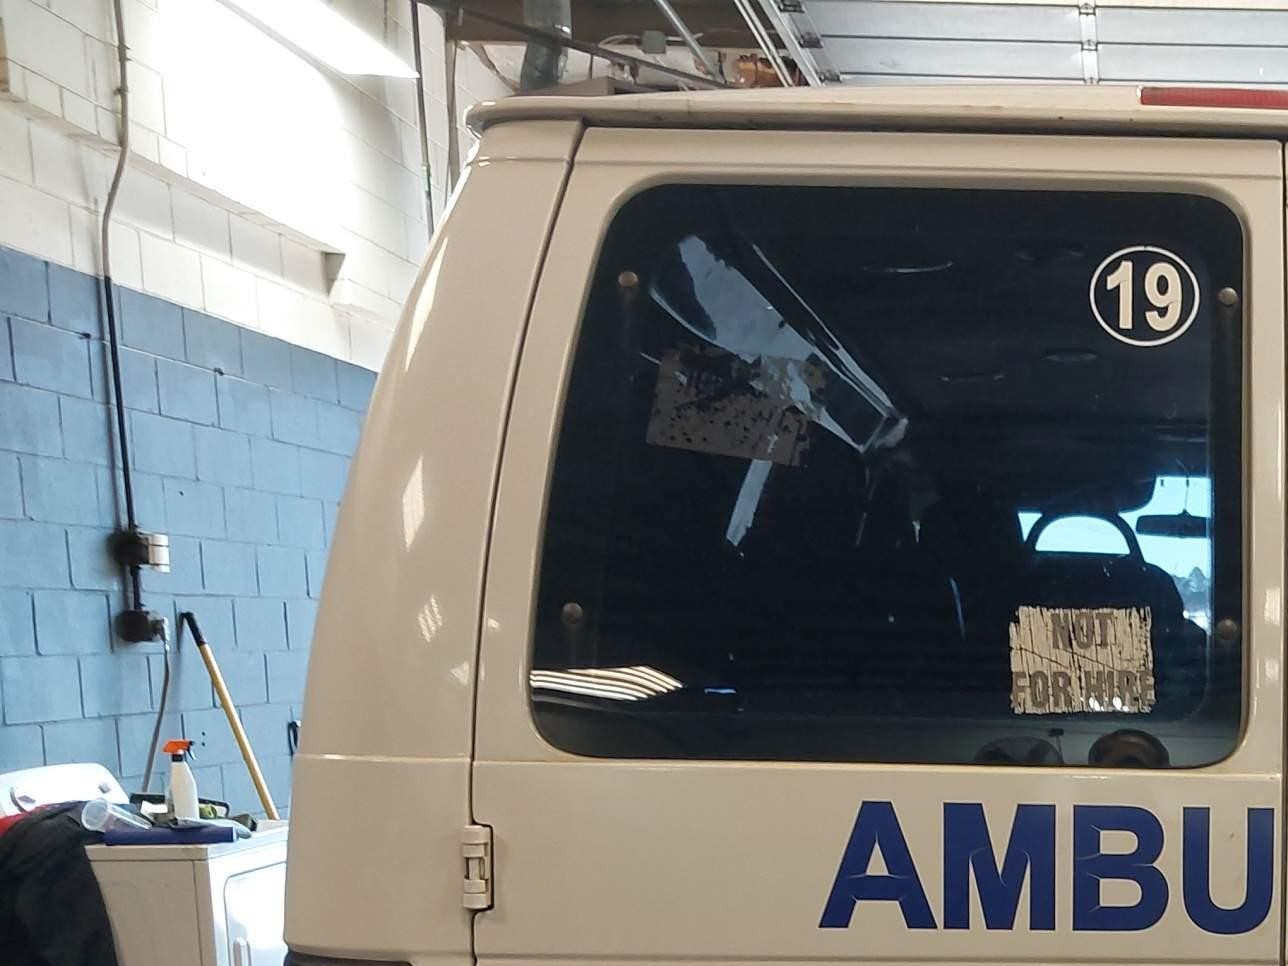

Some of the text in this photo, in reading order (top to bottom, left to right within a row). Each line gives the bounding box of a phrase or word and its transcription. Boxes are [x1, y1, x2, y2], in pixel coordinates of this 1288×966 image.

[1106, 260, 1182, 331] 19
[1051, 612, 1116, 649] NOT
[1012, 670, 1154, 708] FOR HIRE
